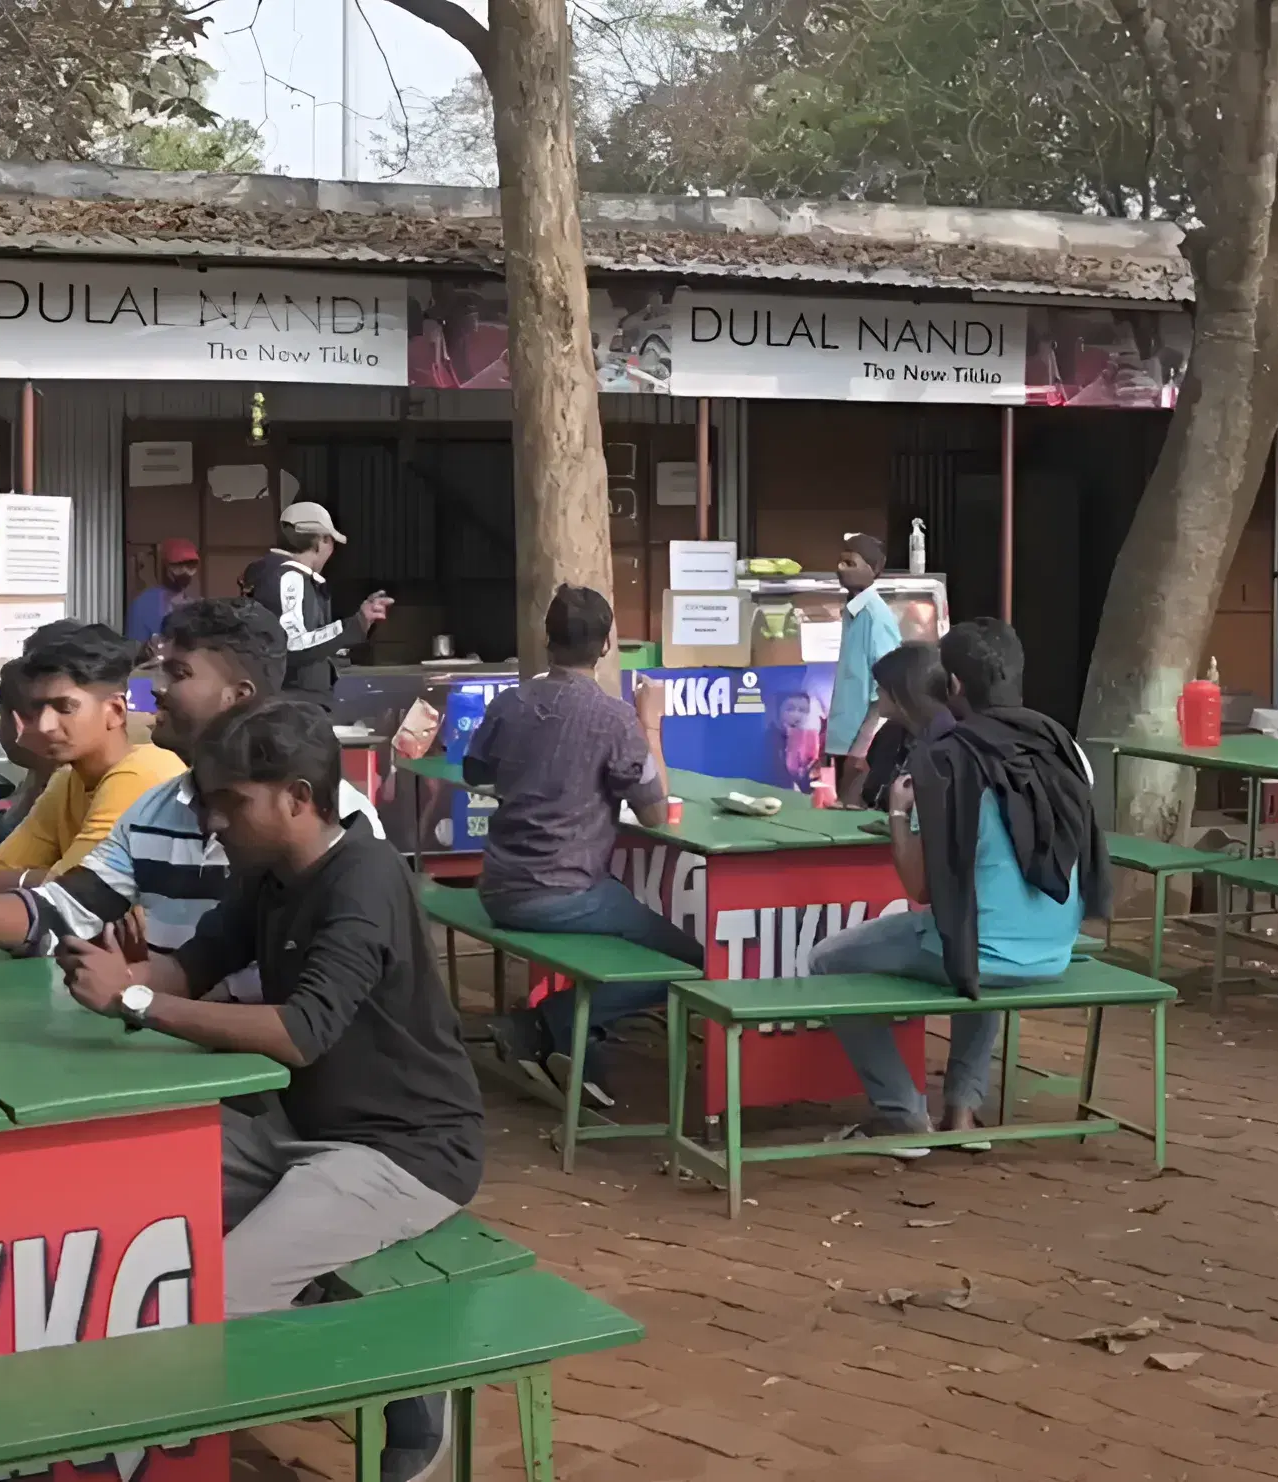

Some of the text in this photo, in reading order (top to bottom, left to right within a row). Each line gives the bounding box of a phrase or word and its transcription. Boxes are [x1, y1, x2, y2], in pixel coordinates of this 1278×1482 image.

[199, 290, 380, 336] NANDI
[691, 306, 1004, 357] DULAL NANDI
[207, 342, 248, 361] The
[863, 362, 895, 380] The
[664, 676, 732, 719] KKA
